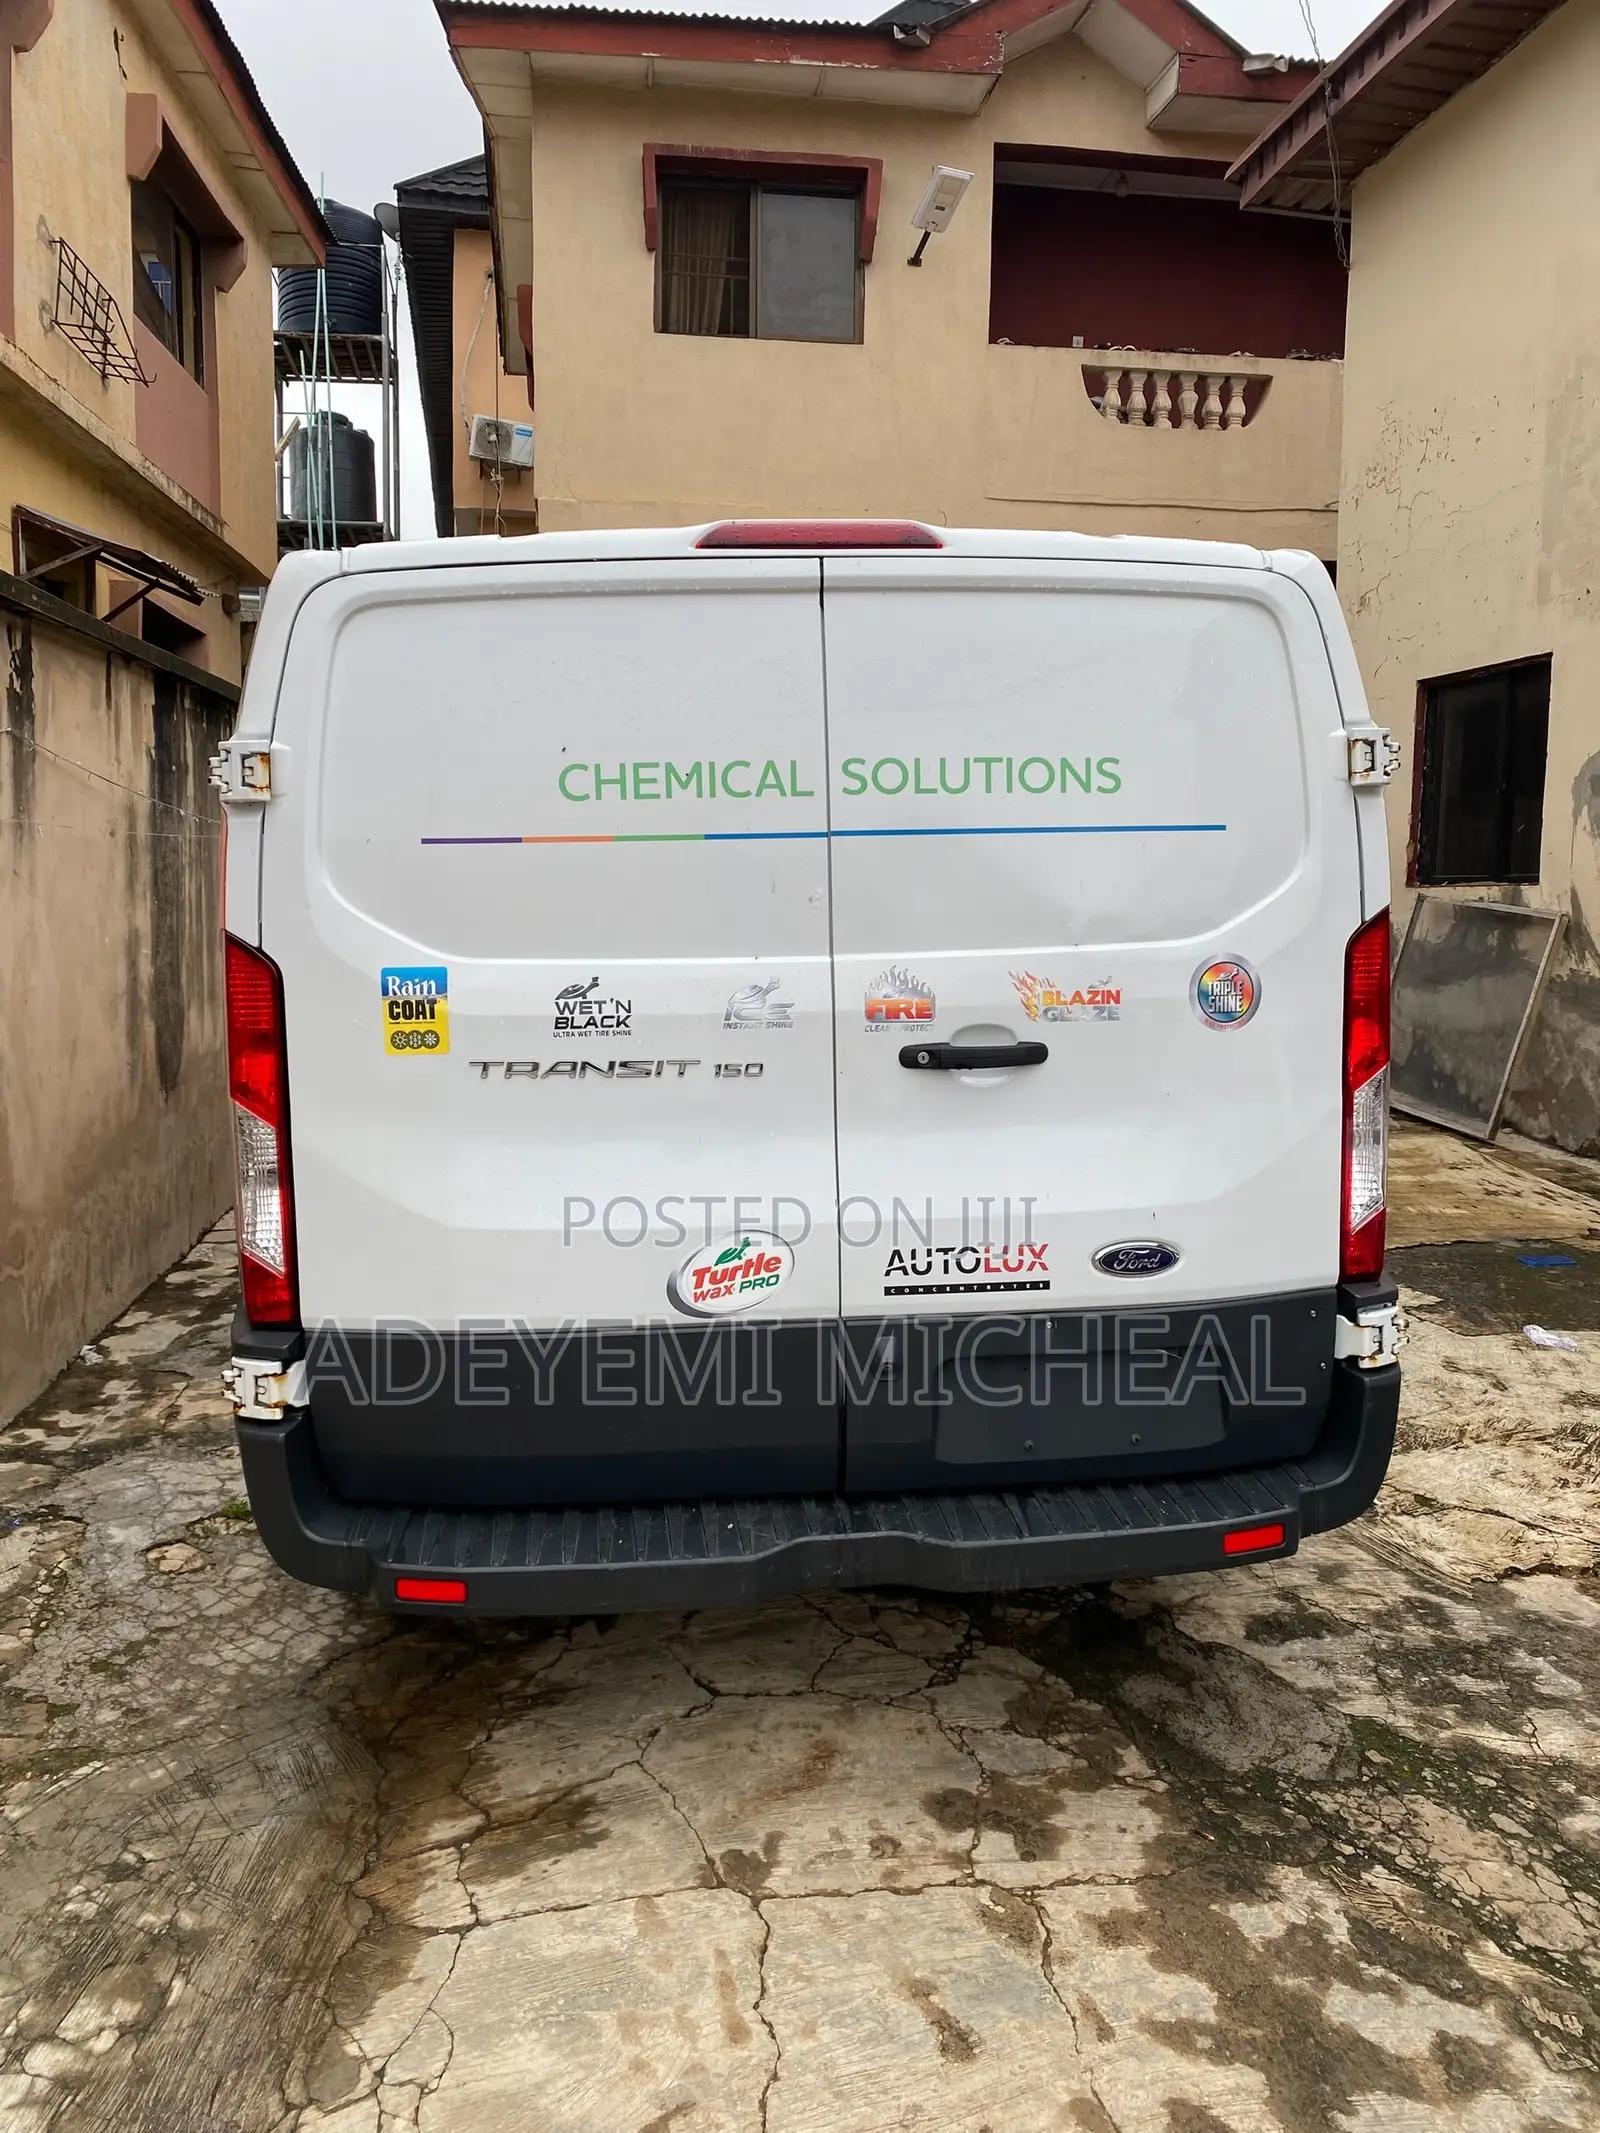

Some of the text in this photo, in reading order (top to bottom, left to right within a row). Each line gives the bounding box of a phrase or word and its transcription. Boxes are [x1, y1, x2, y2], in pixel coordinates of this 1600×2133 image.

[558, 756, 1122, 801] CHEMICAL SOLUTIONS
[385, 975, 437, 997] Rain
[1207, 980, 1244, 996] TRIPLE
[387, 999, 438, 1021] COAT
[723, 1002, 795, 1022] ICE
[866, 998, 933, 1020] FIRE
[1208, 995, 1243, 1013] SHINE
[553, 1015, 632, 1030] BLACK
[722, 1021, 794, 1030] INSTANT SHINE
[577, 1030, 593, 1038] WET
[468, 1059, 764, 1080] TRANSIT 150
[884, 1243, 1049, 1277] AUTOLUX
[1113, 1249, 1162, 1270] Ford
[692, 1252, 783, 1290] Turtle
[739, 1273, 780, 1294] PRO
[890, 1282, 1044, 1294] CONCENTRATES
